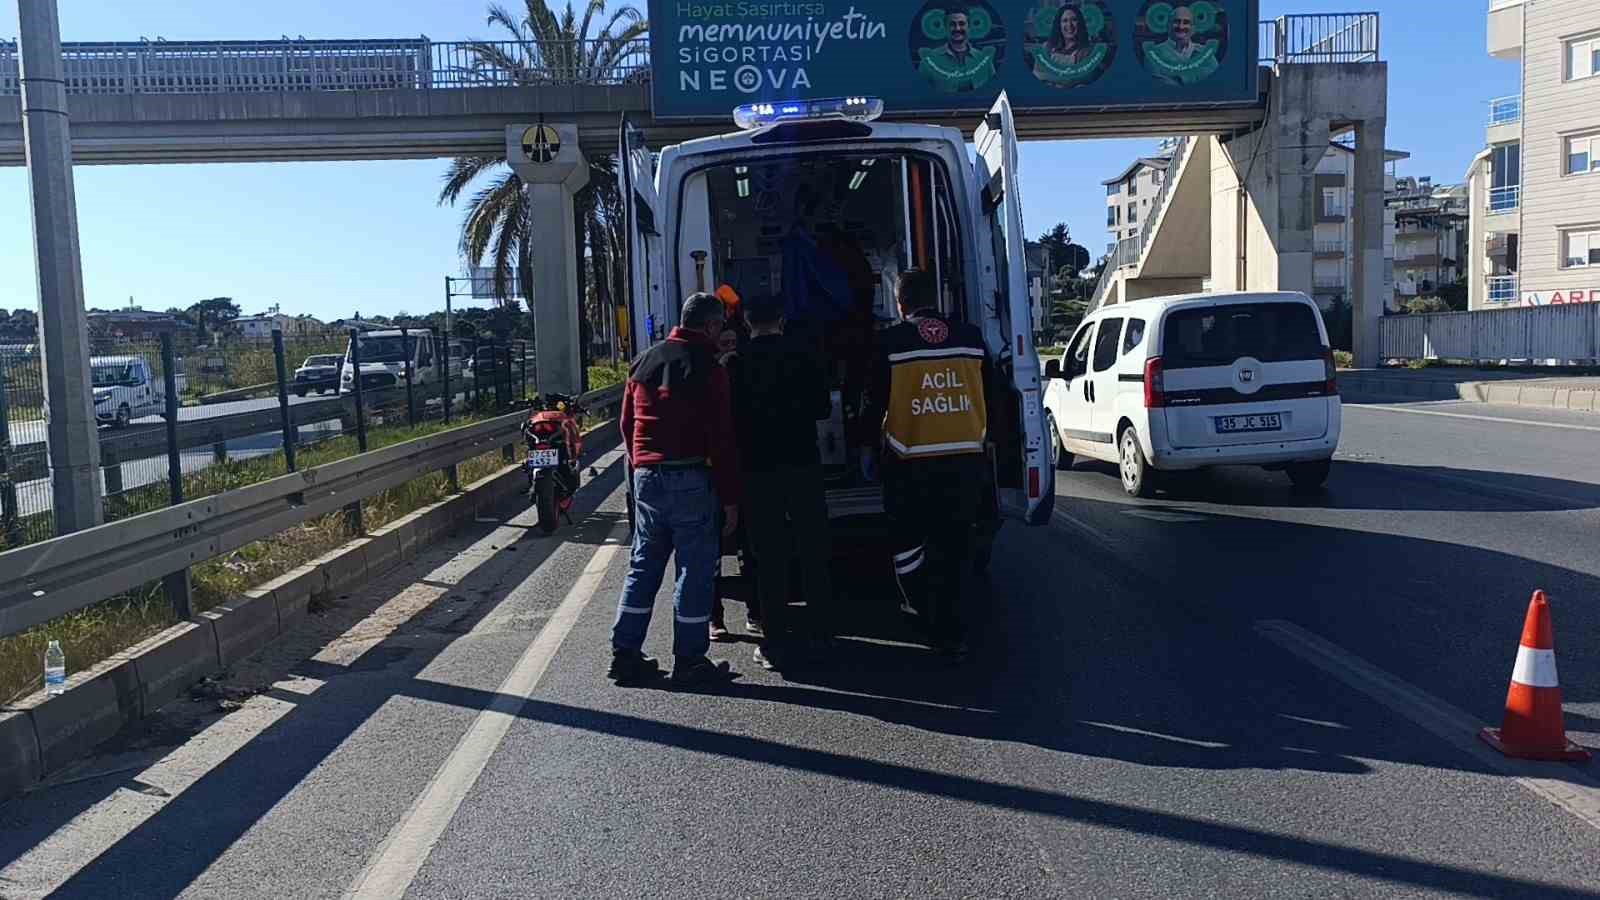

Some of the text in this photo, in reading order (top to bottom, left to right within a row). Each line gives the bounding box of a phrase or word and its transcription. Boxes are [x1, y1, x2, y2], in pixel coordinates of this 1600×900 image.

[677, 2, 733, 19] Hayat
[679, 6, 887, 53] memnuniyetin
[679, 65, 812, 93] NEOVA
[921, 368, 964, 389] ACİL
[1223, 415, 1278, 429] 35 JC 515
